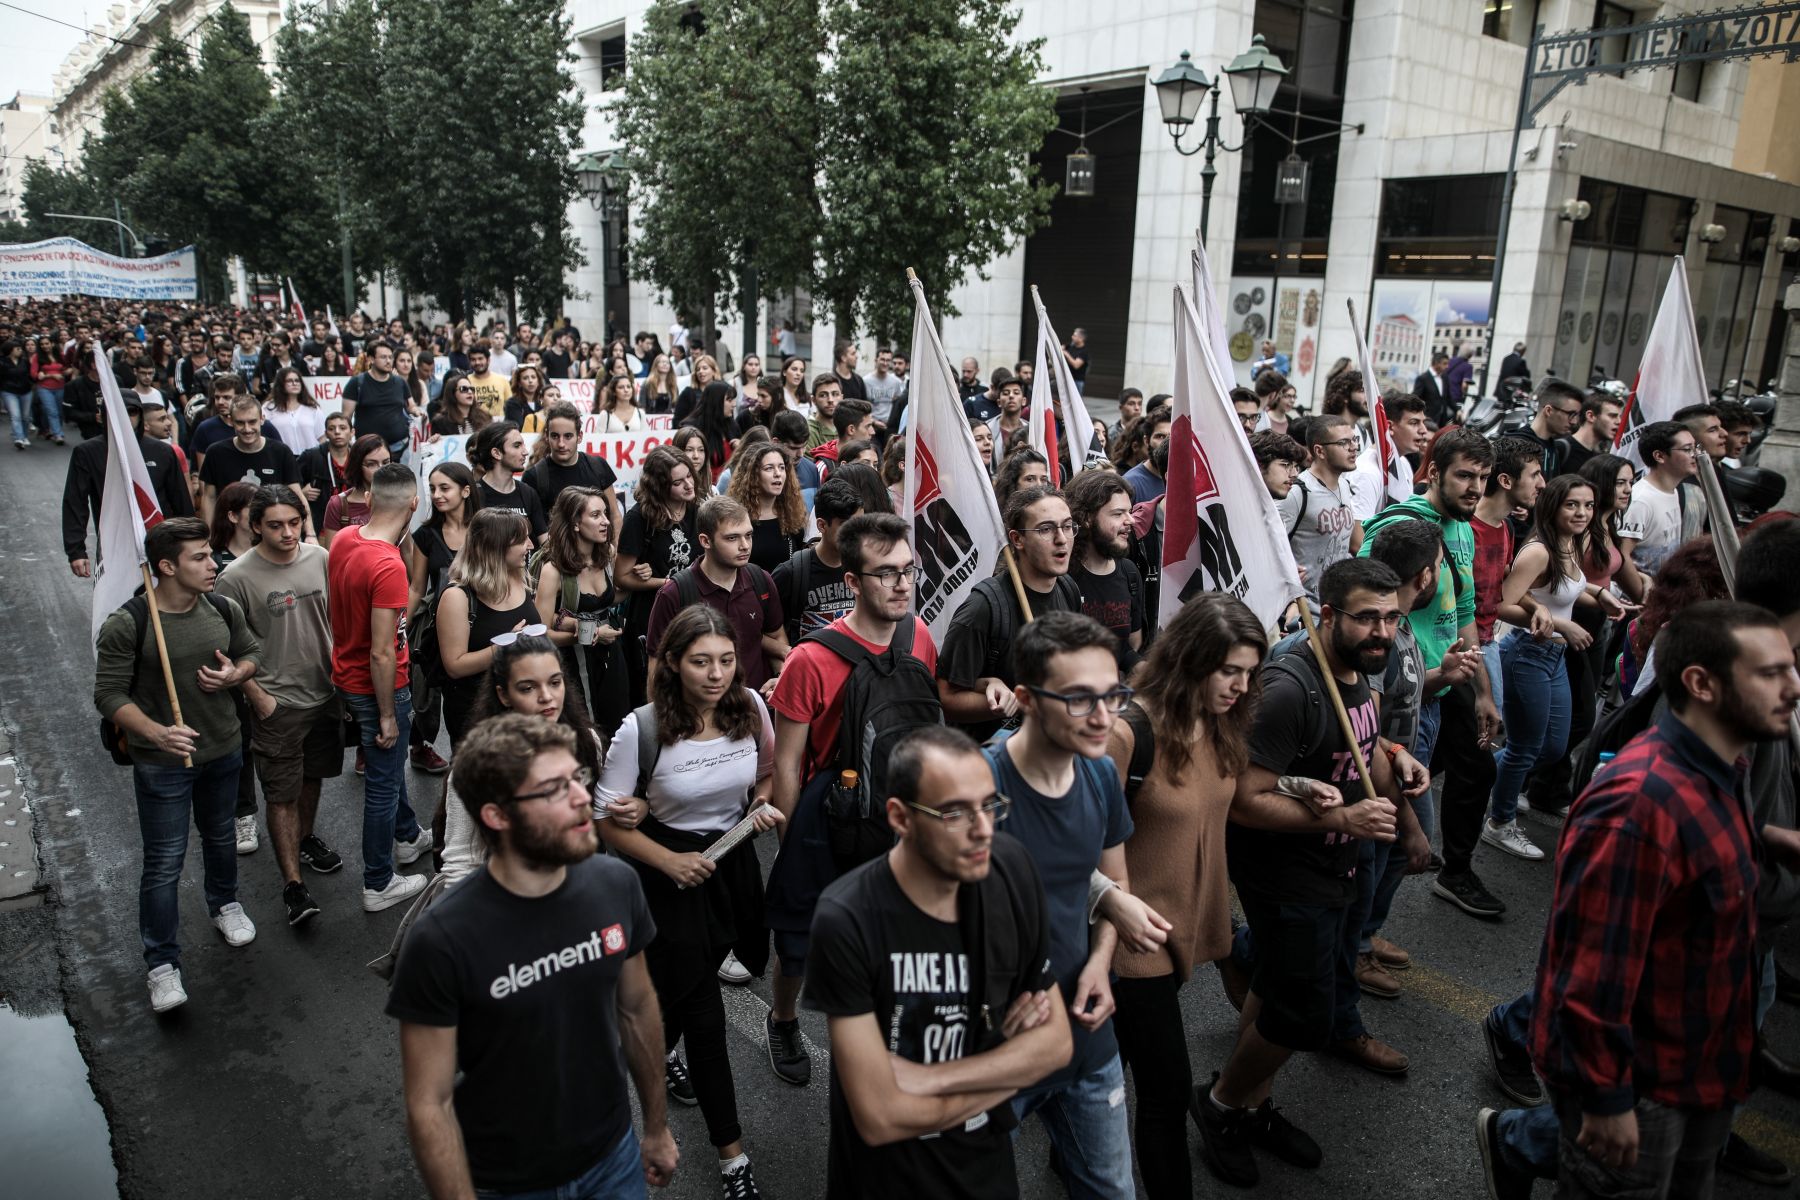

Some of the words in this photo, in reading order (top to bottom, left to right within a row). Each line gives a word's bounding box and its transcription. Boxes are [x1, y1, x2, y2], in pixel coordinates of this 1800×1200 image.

[1540, 38, 1601, 71] ΣΤΟΑ
[719, 748, 745, 761] Company
[490, 930, 602, 999] element
[890, 952, 942, 993] TAKE
[945, 953, 957, 993] A
